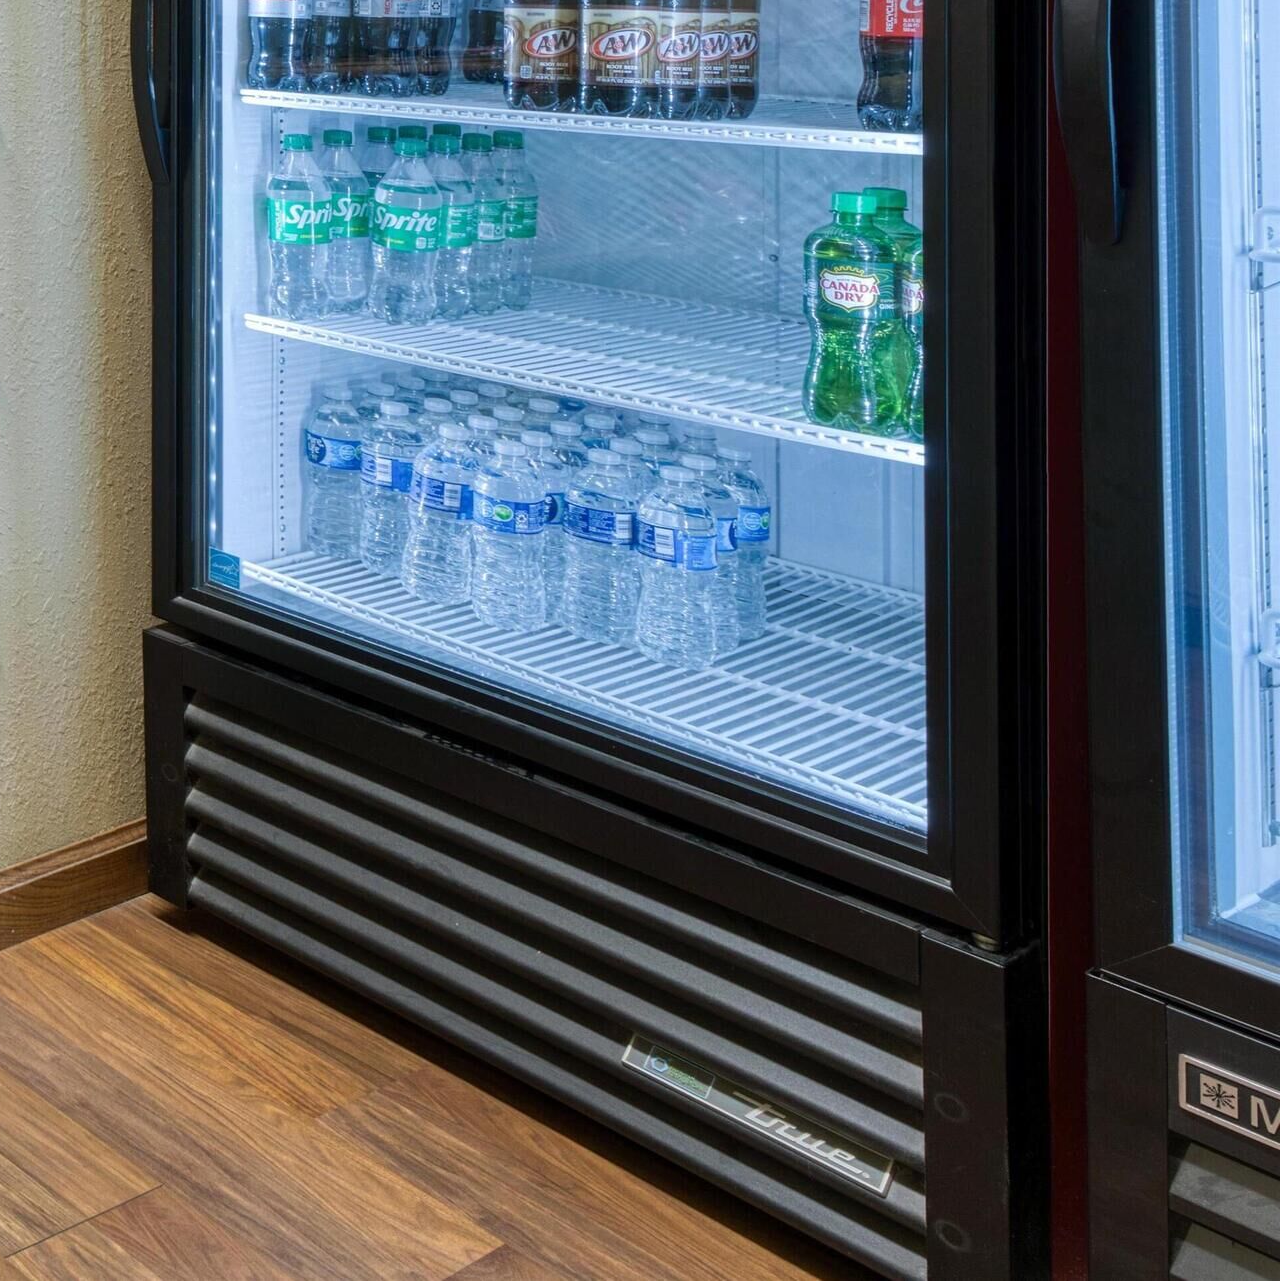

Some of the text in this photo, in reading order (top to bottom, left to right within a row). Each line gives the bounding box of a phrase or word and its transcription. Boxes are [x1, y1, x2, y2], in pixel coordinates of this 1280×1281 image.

[537, 30, 577, 55] A&W
[602, 32, 644, 56] A&W
[664, 34, 697, 57] A&W
[287, 203, 331, 229] Spri
[333, 197, 368, 222] Spr
[375, 207, 437, 232] Sprite
[822, 279, 879, 294] CANADA
[834, 291, 864, 302] DRY
